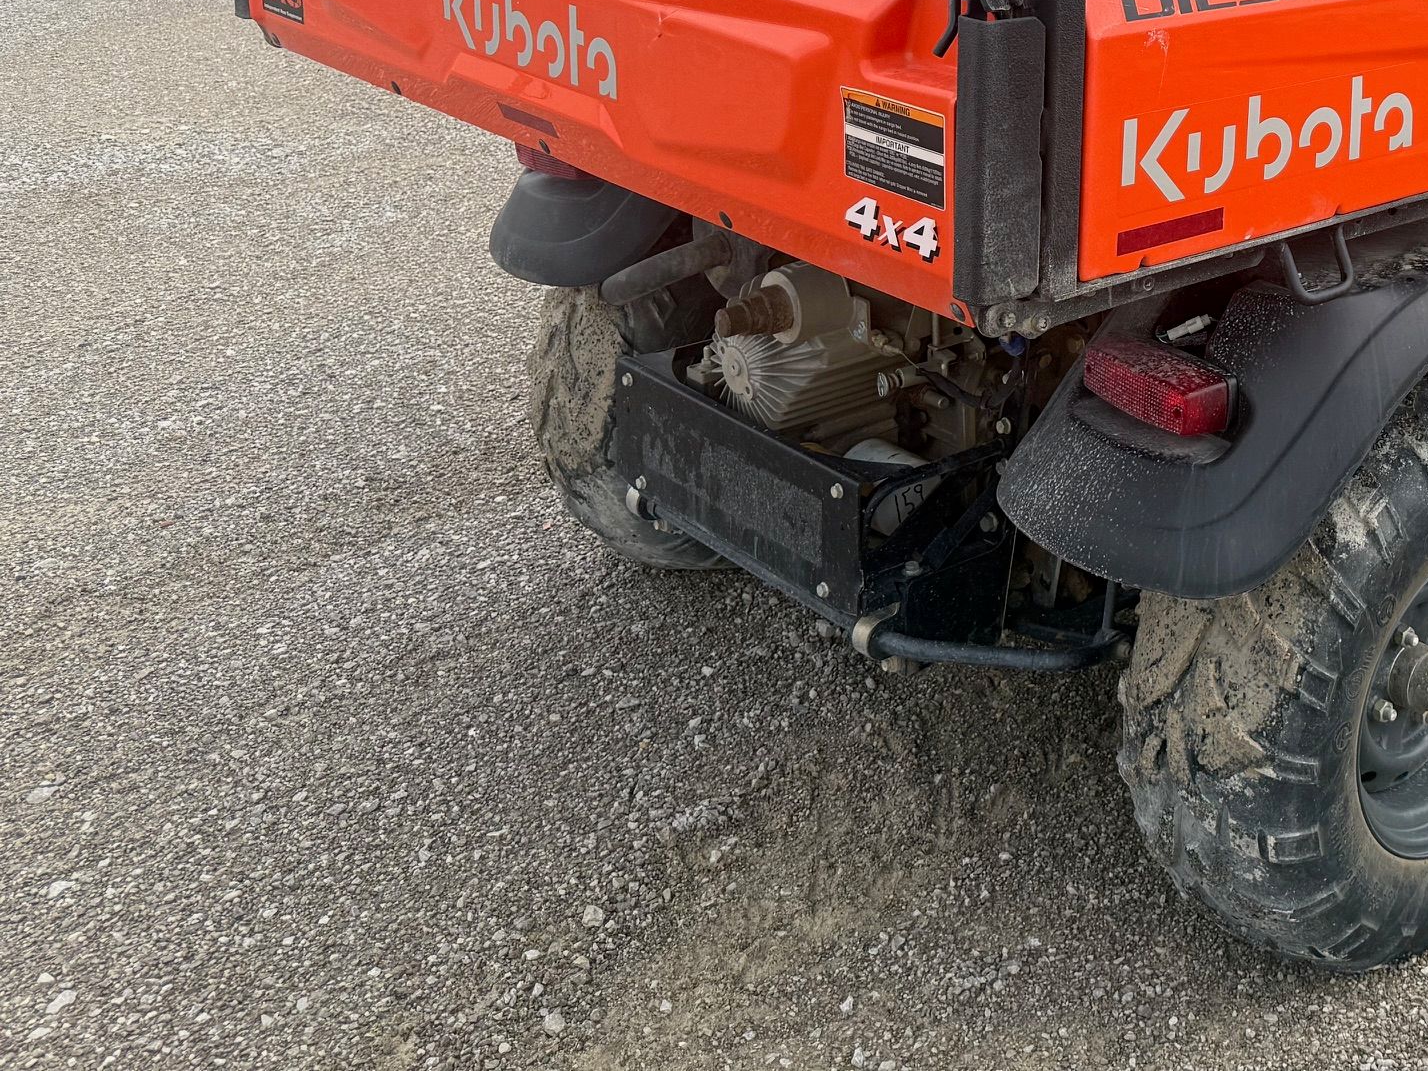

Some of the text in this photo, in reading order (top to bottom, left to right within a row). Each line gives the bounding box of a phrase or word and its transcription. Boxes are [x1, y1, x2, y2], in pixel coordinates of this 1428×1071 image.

[881, 99, 911, 117] WARNING
[875, 135, 910, 154] IMPORTANT
[1121, 75, 1413, 202] Kubota
[845, 196, 941, 263] 4x4
